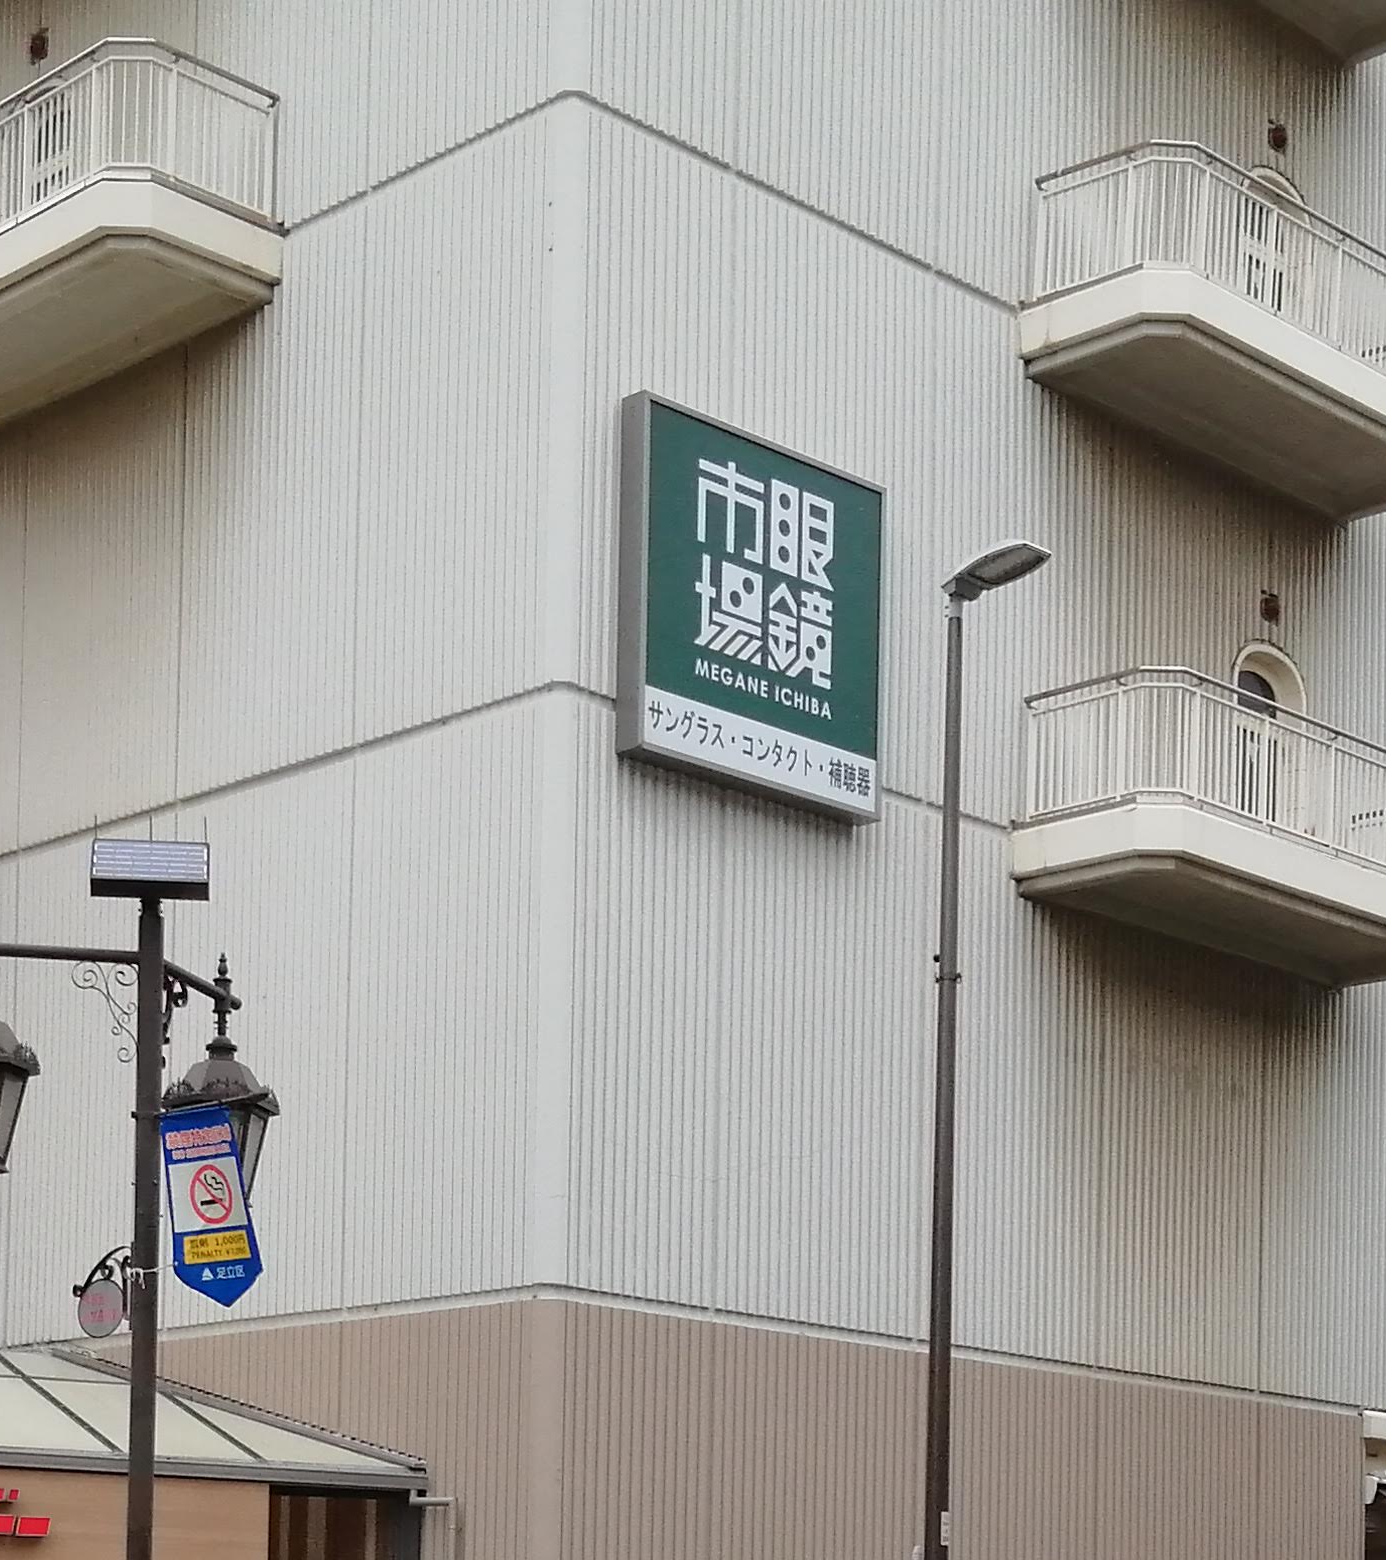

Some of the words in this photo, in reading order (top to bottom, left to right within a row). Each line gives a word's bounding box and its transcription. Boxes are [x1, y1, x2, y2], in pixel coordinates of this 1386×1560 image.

[694, 657, 769, 698] MEGANE
[774, 685, 833, 721] ICHIBA
[216, 1265, 245, 1279] 足立区
